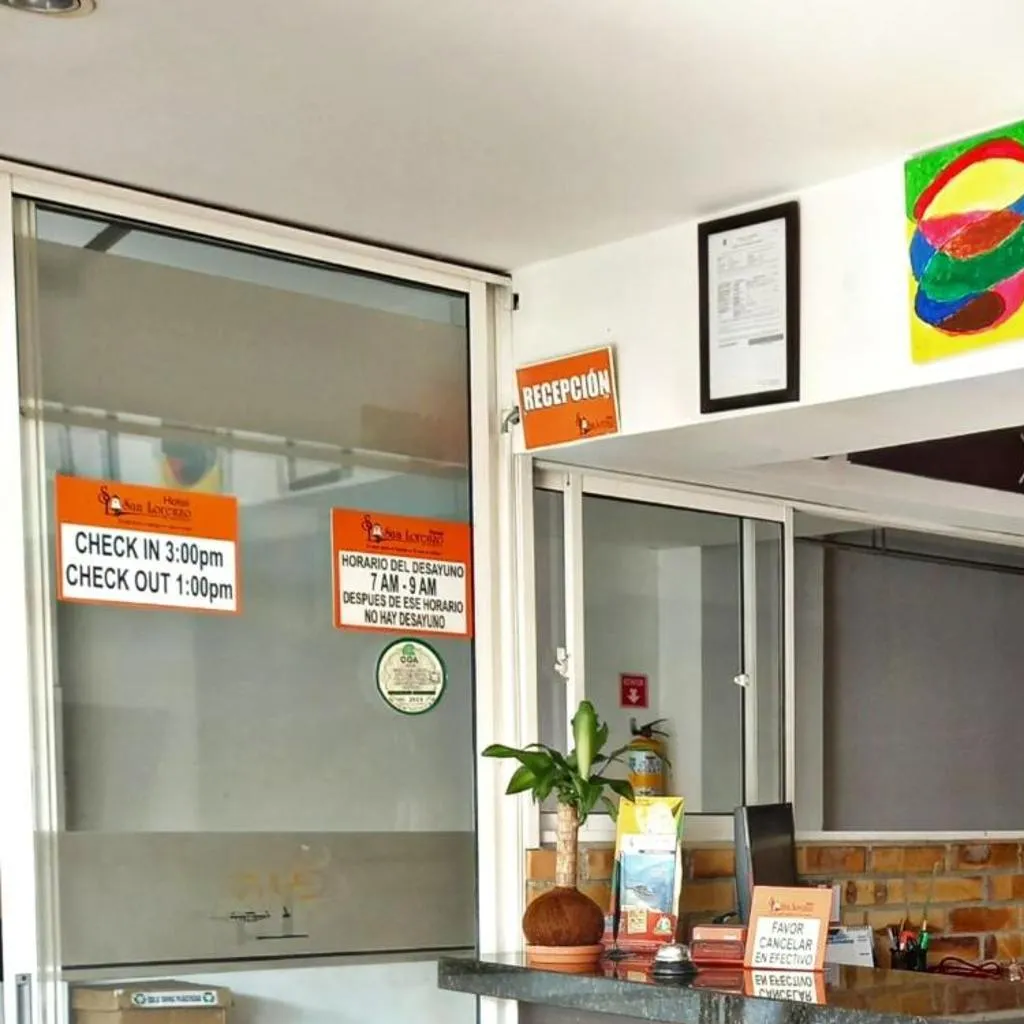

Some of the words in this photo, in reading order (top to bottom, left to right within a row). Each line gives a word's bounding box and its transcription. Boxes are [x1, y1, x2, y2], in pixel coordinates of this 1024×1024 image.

[522, 368, 611, 411] RECEPCIÓN
[75, 531, 139, 560] CHECK
[143, 538, 160, 561] IN
[165, 540, 224, 572] 3:00pm
[342, 554, 388, 571] HORARIO
[390, 559, 410, 573] DEL
[412, 561, 464, 578] DESAYUNO
[66, 563, 130, 591] CHECK
[134, 570, 171, 594] OUT
[175, 574, 233, 603] 1:00pm
[371, 572, 378, 591] 7
[380, 573, 399, 593] AM
[409, 576, 416, 594] 9
[419, 578, 437, 596] AM
[343, 591, 386, 607] DESPUES
[388, 595, 401, 609] DE
[403, 597, 421, 610] ESE
[422, 598, 464, 614] HORARIO
[364, 609, 378, 624] NO
[380, 609, 397, 625] HAY
[399, 611, 446, 629] DESAYUNO
[772, 921, 804, 936] FAVOR
[759, 936, 813, 952] CANCELAR
[755, 952, 767, 964] EN
[769, 952, 813, 966] EFECTIVO
